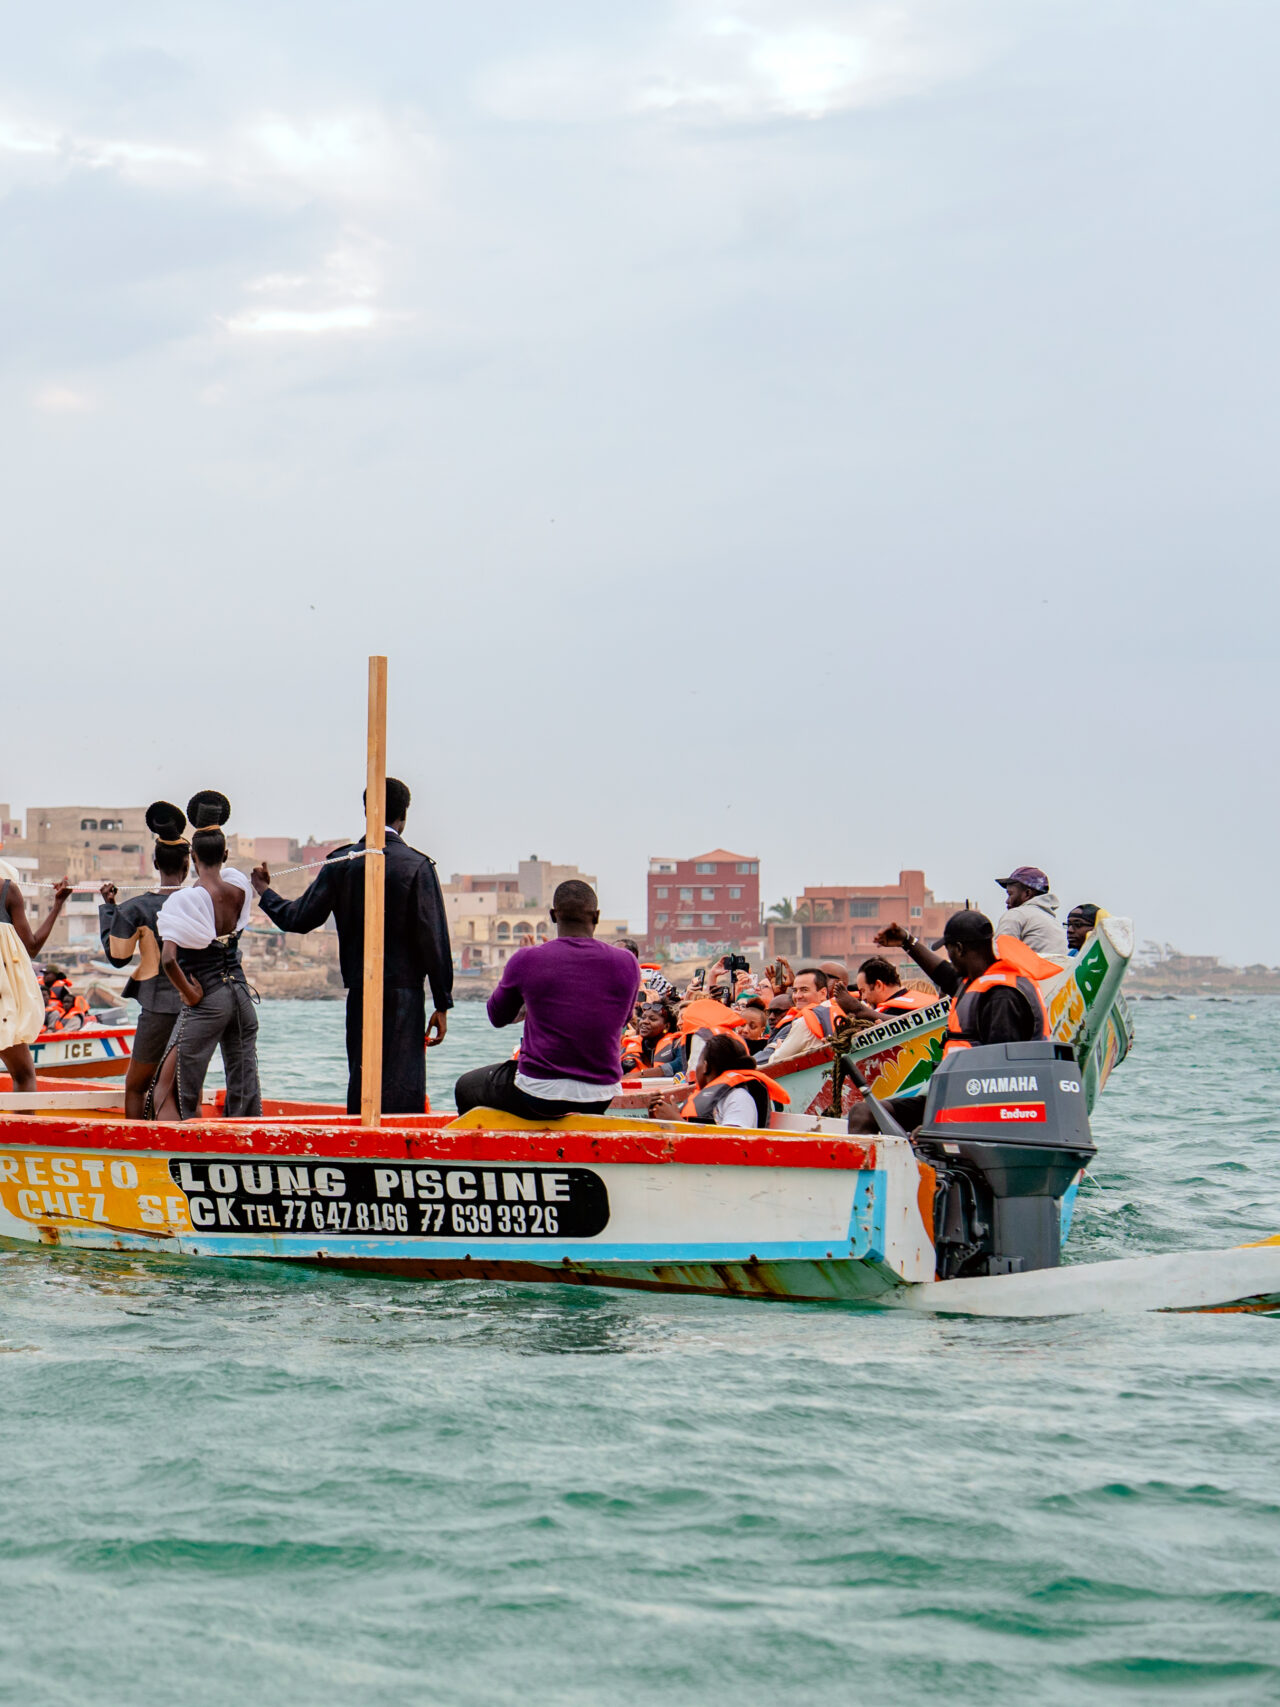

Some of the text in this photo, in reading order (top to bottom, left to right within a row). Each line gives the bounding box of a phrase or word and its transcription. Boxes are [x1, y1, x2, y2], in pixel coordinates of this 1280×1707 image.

[855, 1017, 911, 1048] AMPION
[64, 1042, 93, 1059] ICE
[981, 1076, 1038, 1093] YAMAHA
[1059, 1079, 1080, 1093] 60
[1000, 1108, 1037, 1119] Enduro
[178, 1162, 346, 1197] LOUNG
[374, 1169, 571, 1202] PISCINE
[17, 1189, 109, 1222] CHEZ
[242, 1204, 281, 1227] TEL
